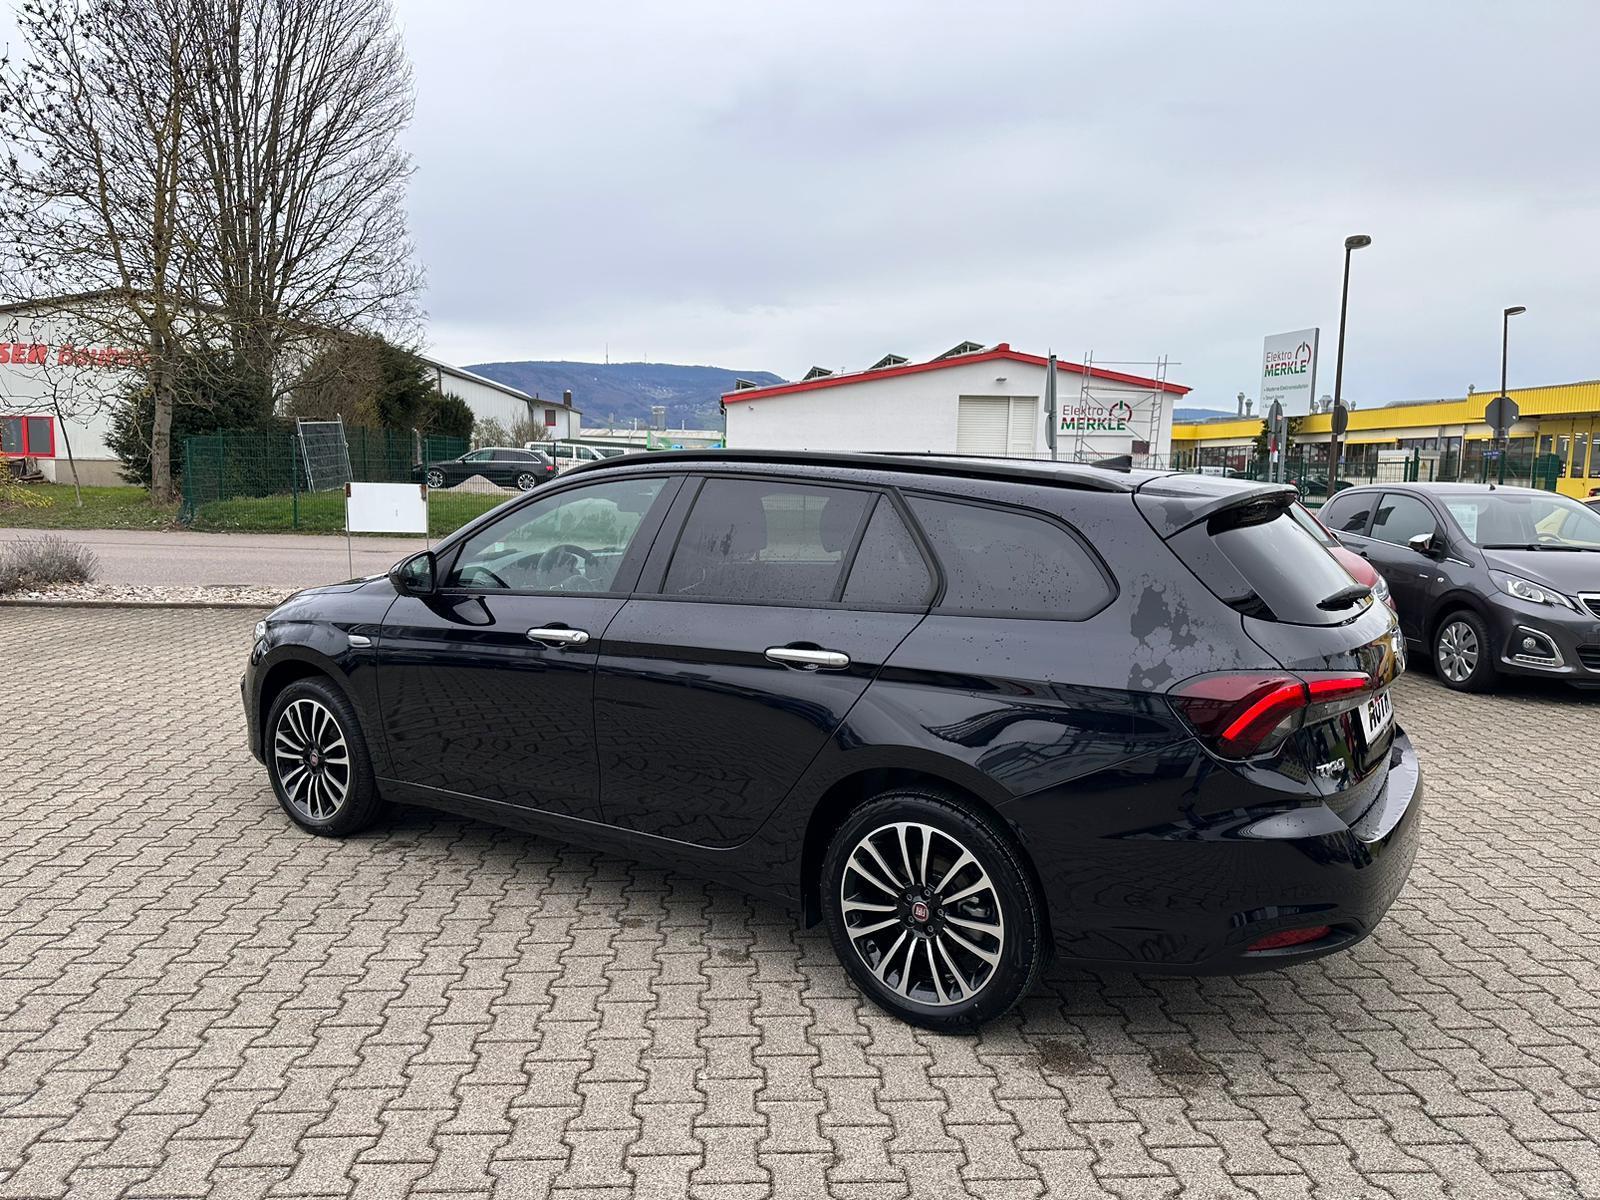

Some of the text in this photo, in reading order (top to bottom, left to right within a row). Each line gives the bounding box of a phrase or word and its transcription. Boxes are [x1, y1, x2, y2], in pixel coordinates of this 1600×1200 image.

[1266, 351, 1292, 363] Elektro
[1264, 359, 1307, 377] MERKLE
[1062, 404, 1104, 416] Elektro
[1060, 417, 1126, 430] MERKLE
